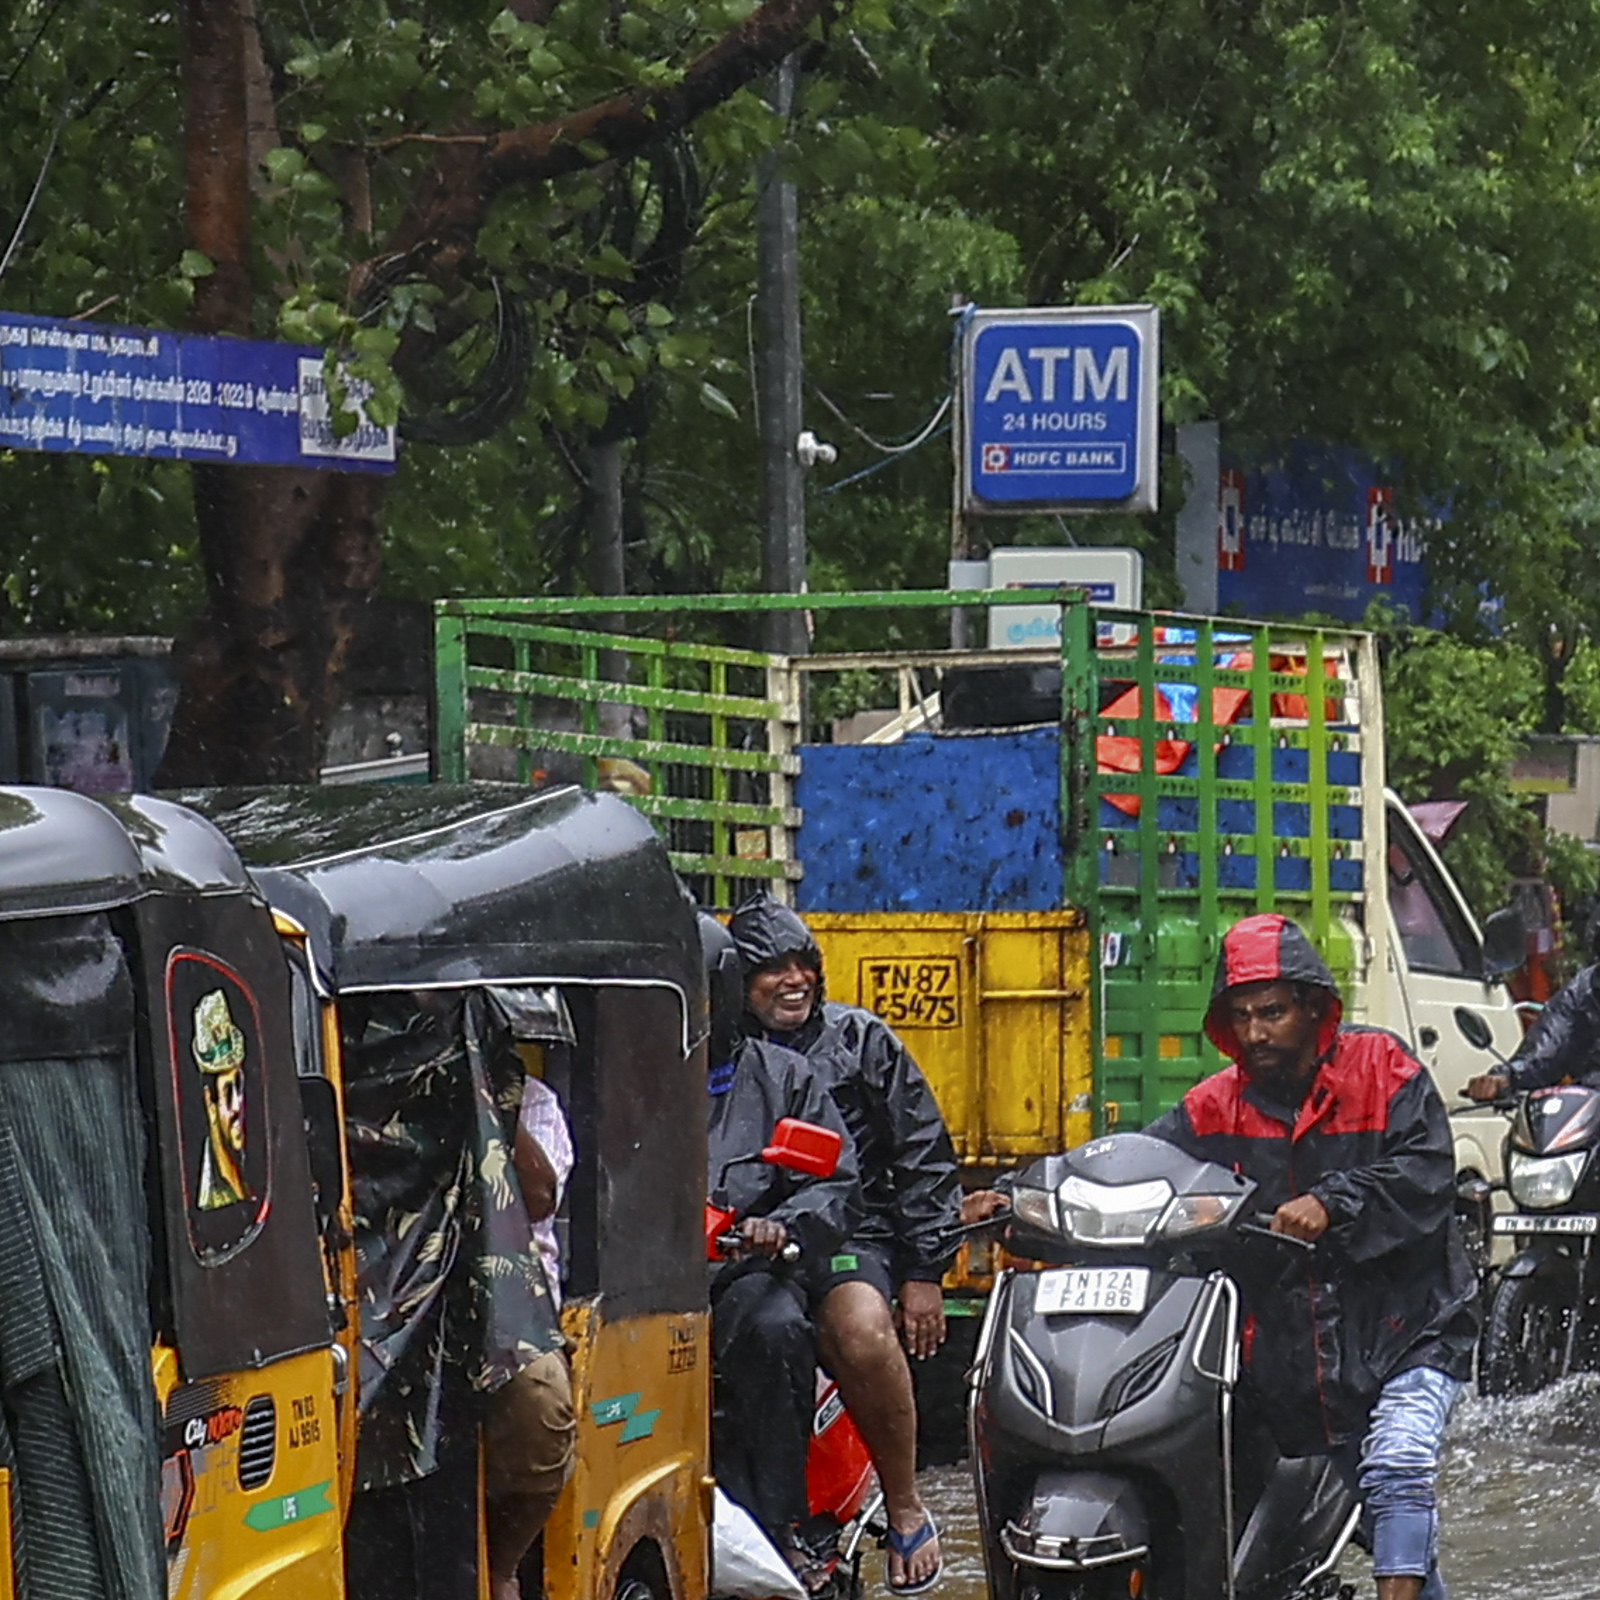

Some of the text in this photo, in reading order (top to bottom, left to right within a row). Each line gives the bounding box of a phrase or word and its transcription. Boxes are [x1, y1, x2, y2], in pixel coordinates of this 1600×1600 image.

[984, 346, 1129, 402] ATM
[1003, 412, 1107, 431] 24 HOURS
[1013, 451, 1115, 465] HDFC BANK
[915, 965, 951, 992] 87
[873, 994, 956, 1024] C5475
[1064, 1271, 1134, 1290] TN12A
[1059, 1290, 1132, 1309] F4186
[185, 1418, 207, 1446] City
